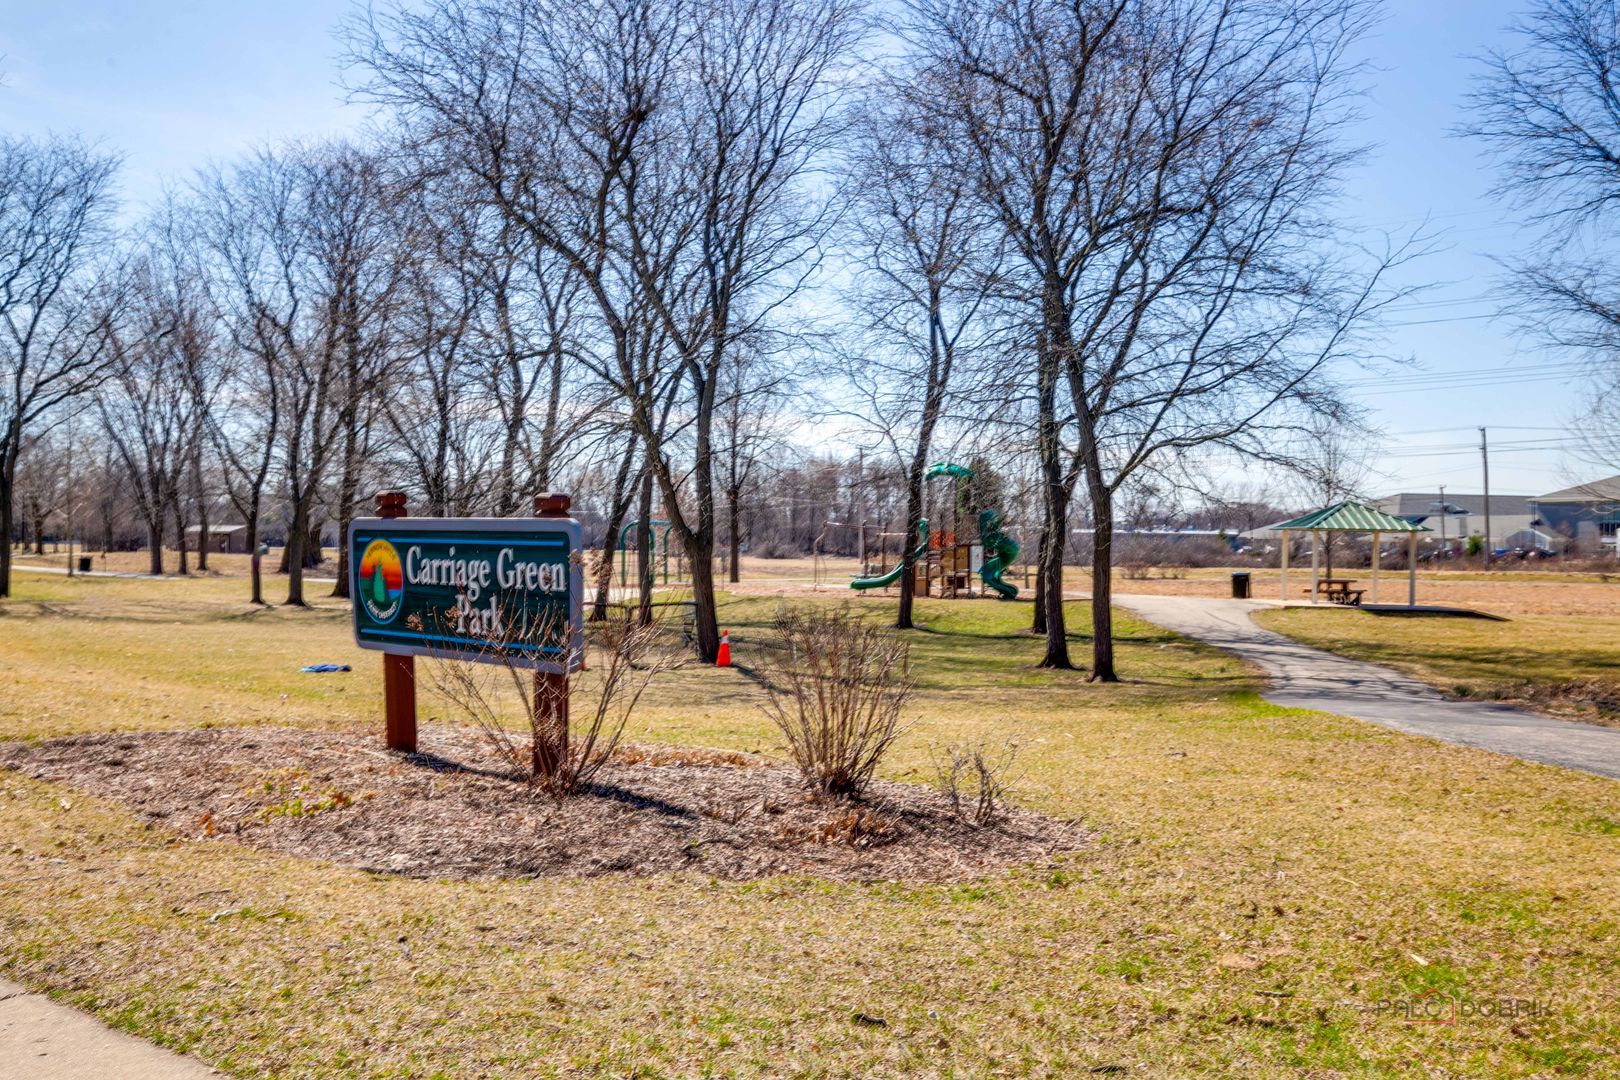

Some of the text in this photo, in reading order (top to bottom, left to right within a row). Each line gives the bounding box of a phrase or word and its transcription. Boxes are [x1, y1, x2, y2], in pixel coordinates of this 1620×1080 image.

[406, 545, 567, 601] Carriage Green
[455, 593, 505, 638] Park
